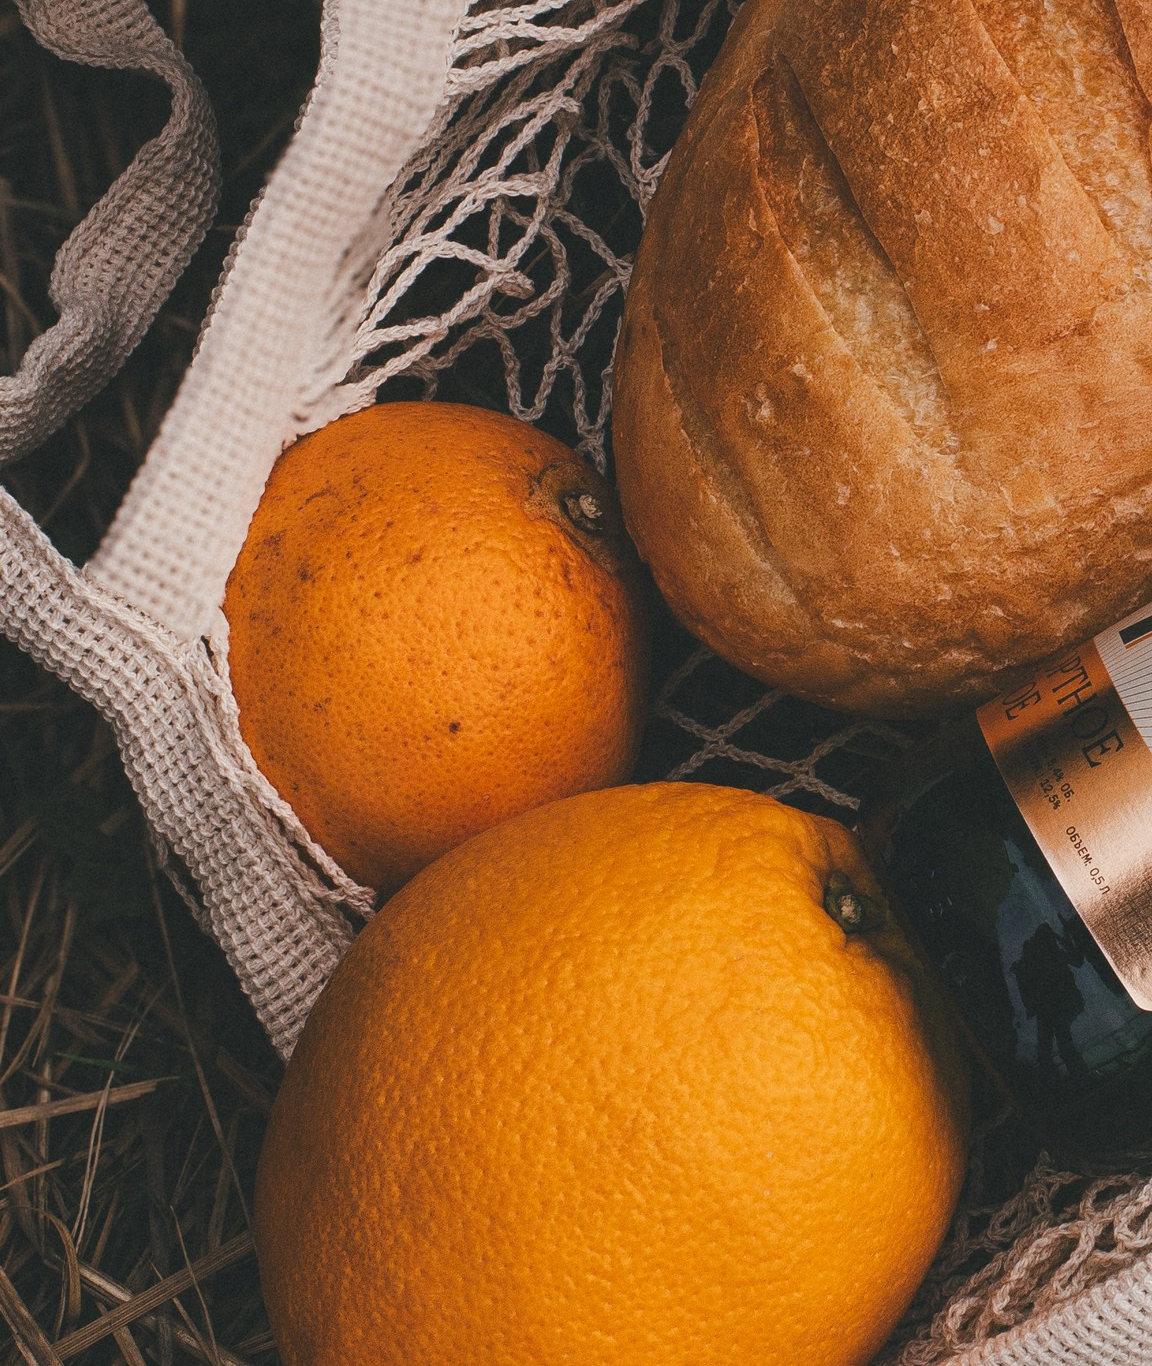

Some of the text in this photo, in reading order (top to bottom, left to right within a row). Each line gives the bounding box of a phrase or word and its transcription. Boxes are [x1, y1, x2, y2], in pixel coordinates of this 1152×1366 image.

[1039, 779, 1062, 810] 12,5%
[1060, 783, 1075, 803] ОБ.
[1066, 826, 1110, 895] ОБЪЕМ: 0,5 Л
